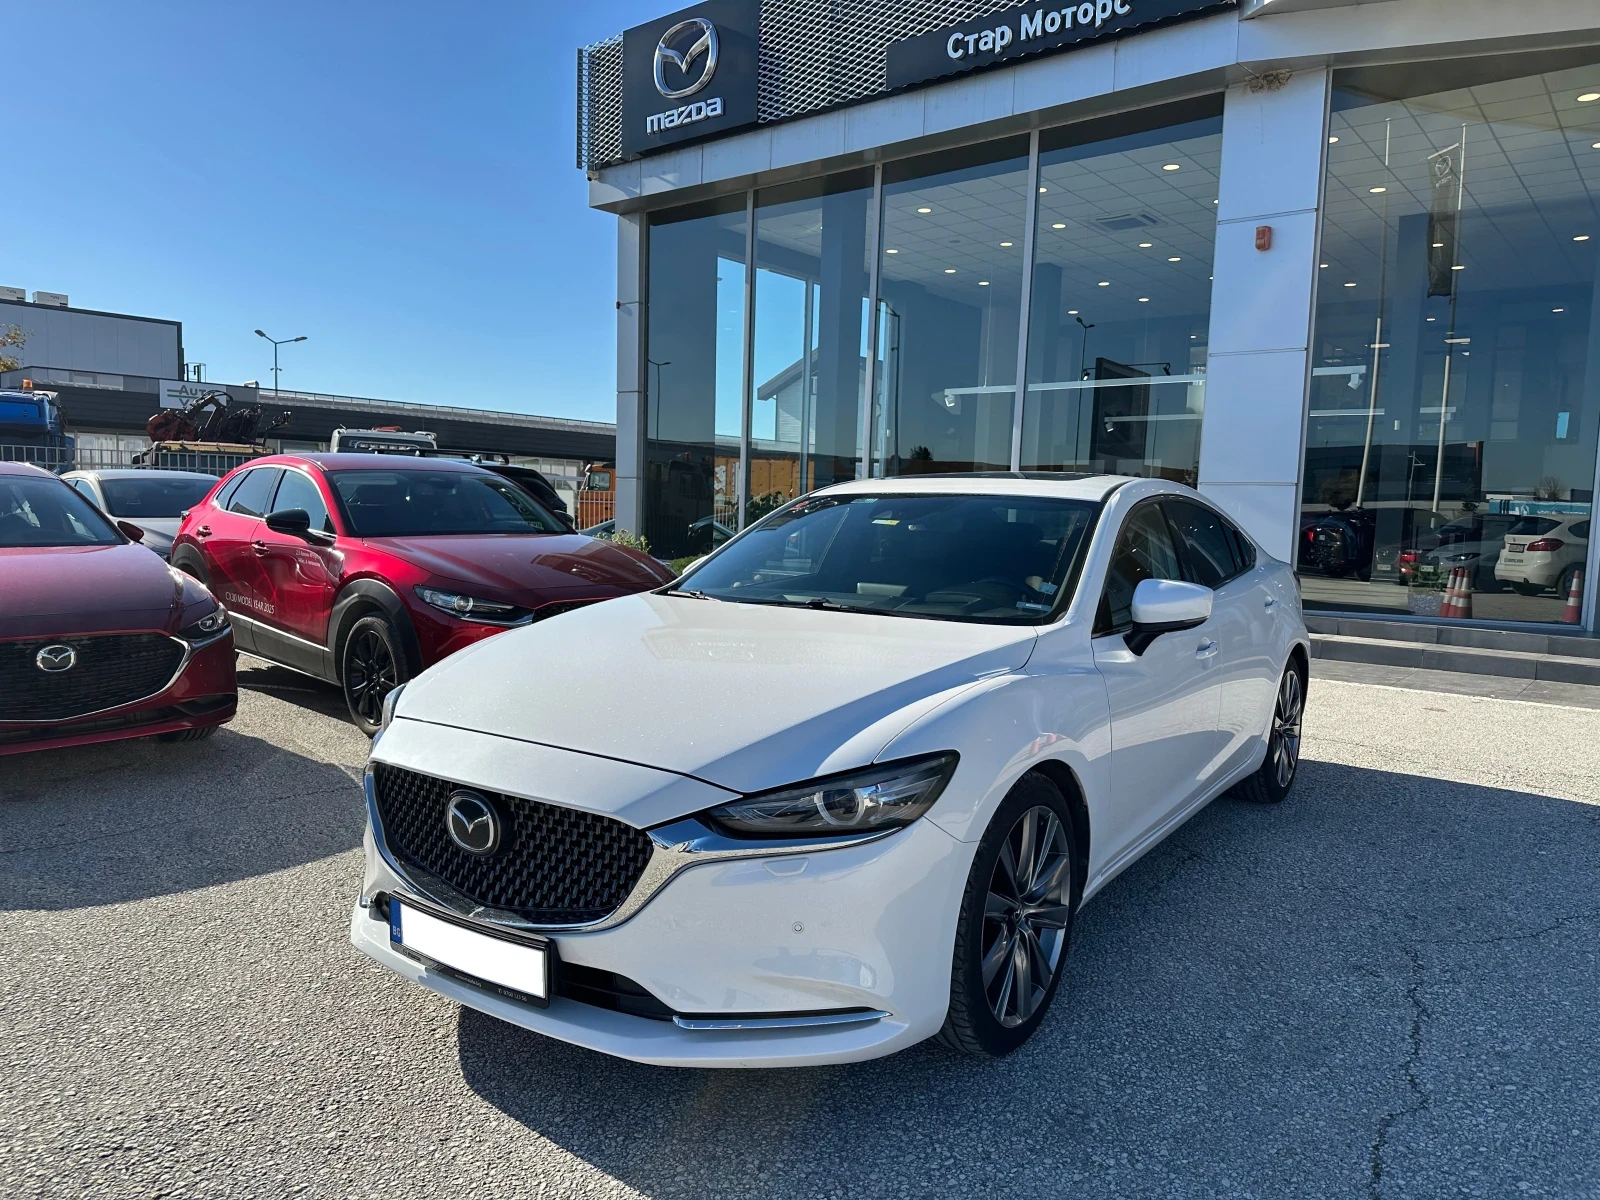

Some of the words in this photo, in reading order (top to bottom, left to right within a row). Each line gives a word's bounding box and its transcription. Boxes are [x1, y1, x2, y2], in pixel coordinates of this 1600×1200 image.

[946, 25, 1013, 60] Стар
[1020, 0, 1132, 40] Моторс
[646, 97, 725, 136] mazda
[237, 594, 253, 608] MODEL
[252, 598, 264, 612] YEAR
[263, 602, 275, 615] 2025
[392, 925, 401, 937] BG
